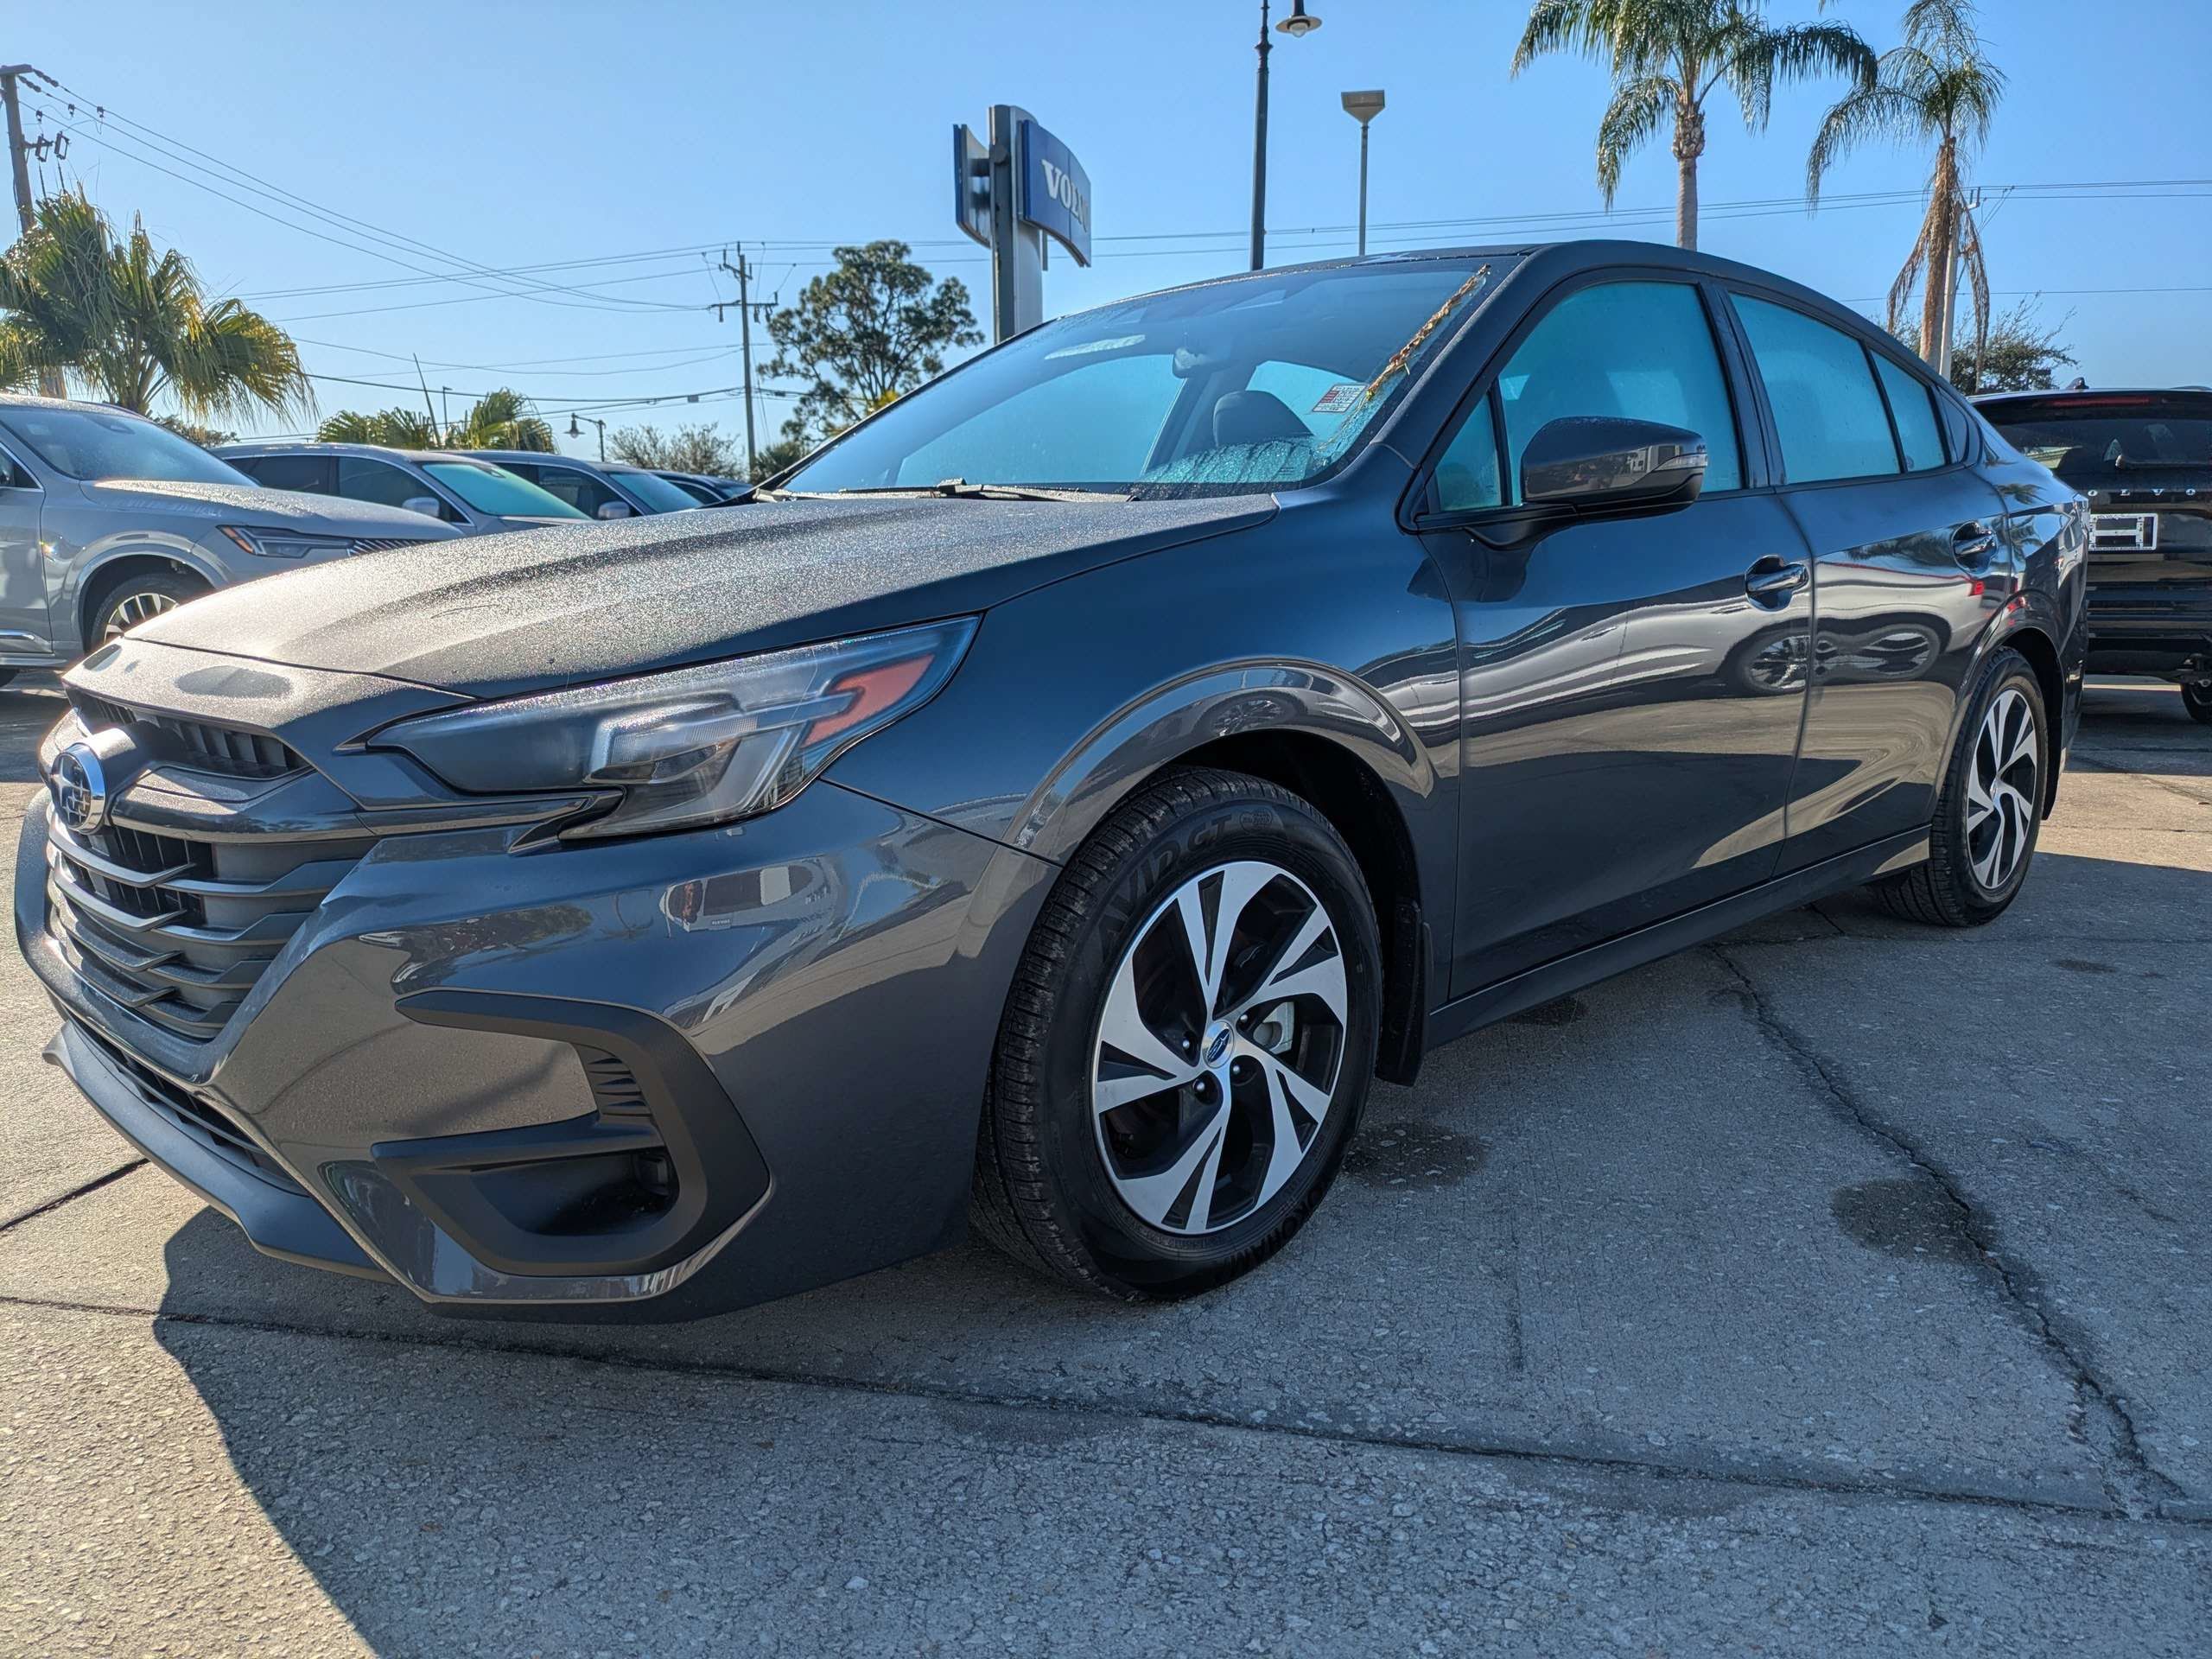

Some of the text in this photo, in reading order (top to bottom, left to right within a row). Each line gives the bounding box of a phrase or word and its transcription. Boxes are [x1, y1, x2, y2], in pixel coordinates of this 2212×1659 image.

[1041, 159, 1088, 232] VOLV
[2088, 488, 2196, 497] OLVO
[1187, 814, 1232, 851] GT
